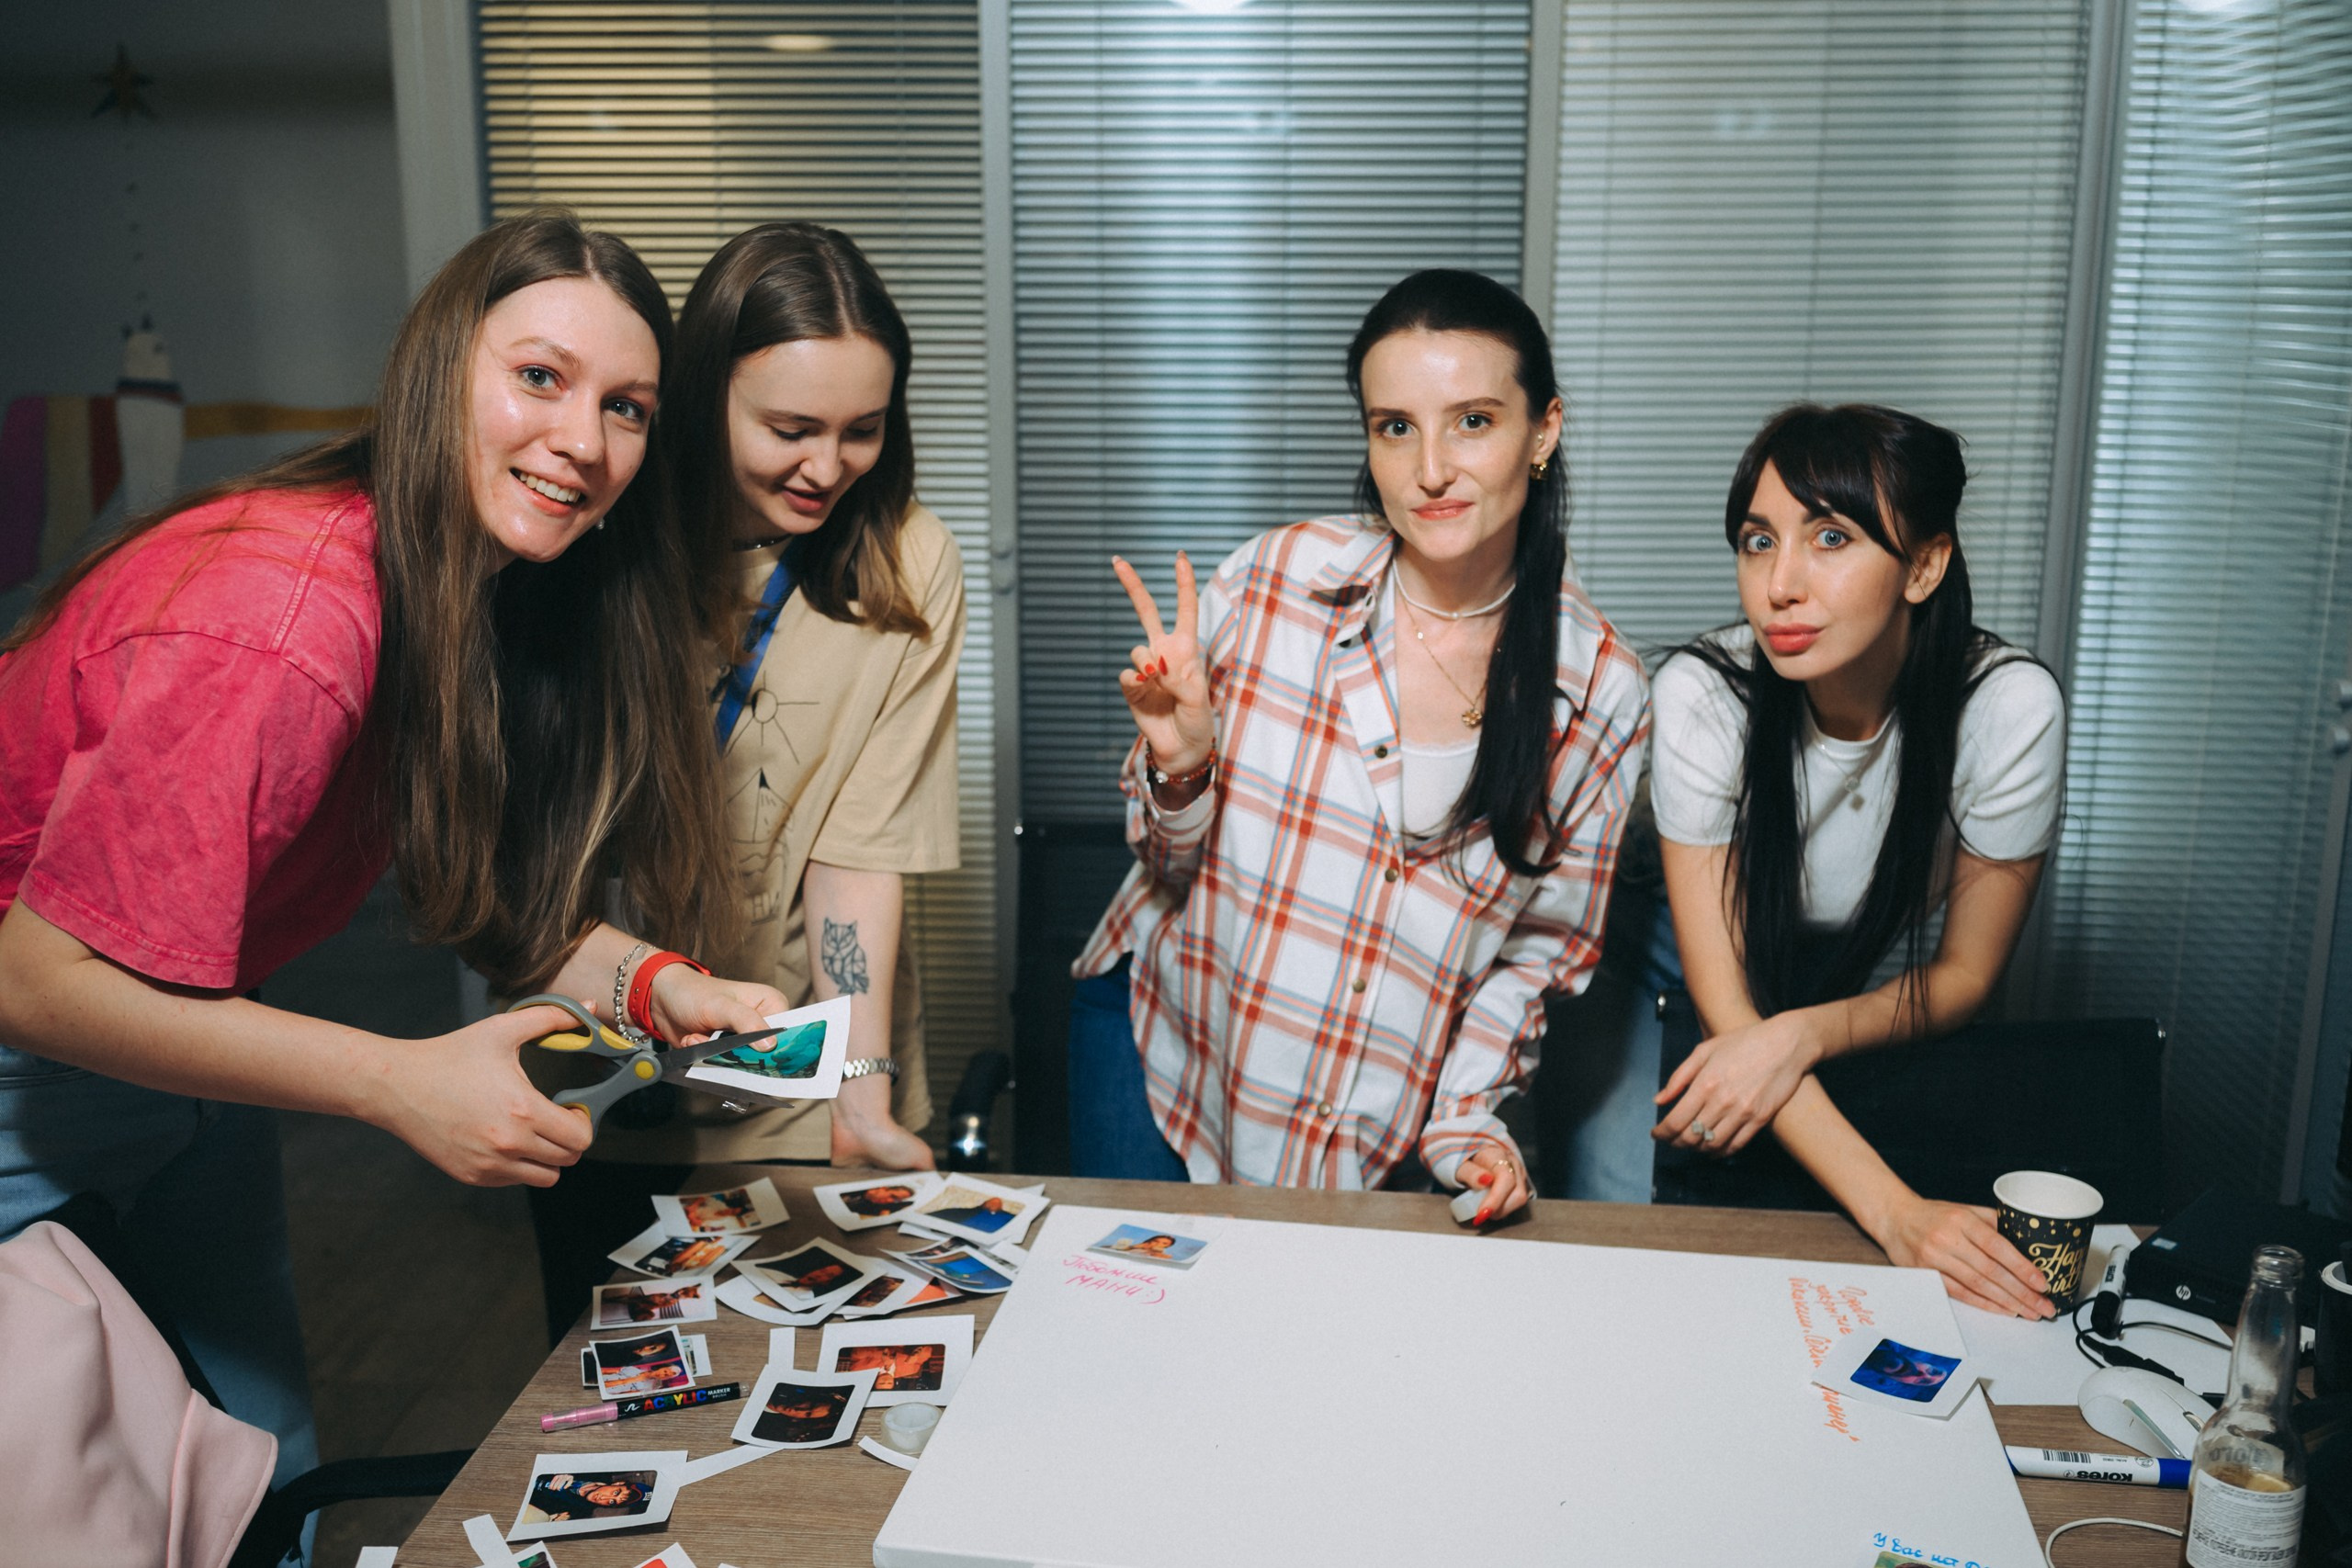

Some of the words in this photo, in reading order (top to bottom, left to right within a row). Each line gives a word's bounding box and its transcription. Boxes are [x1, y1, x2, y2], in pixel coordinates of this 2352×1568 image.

[2177, 1285, 2190, 1301] hp
[643, 1390, 707, 1412] ACRYLIC
[707, 1387, 730, 1396] MARKER
